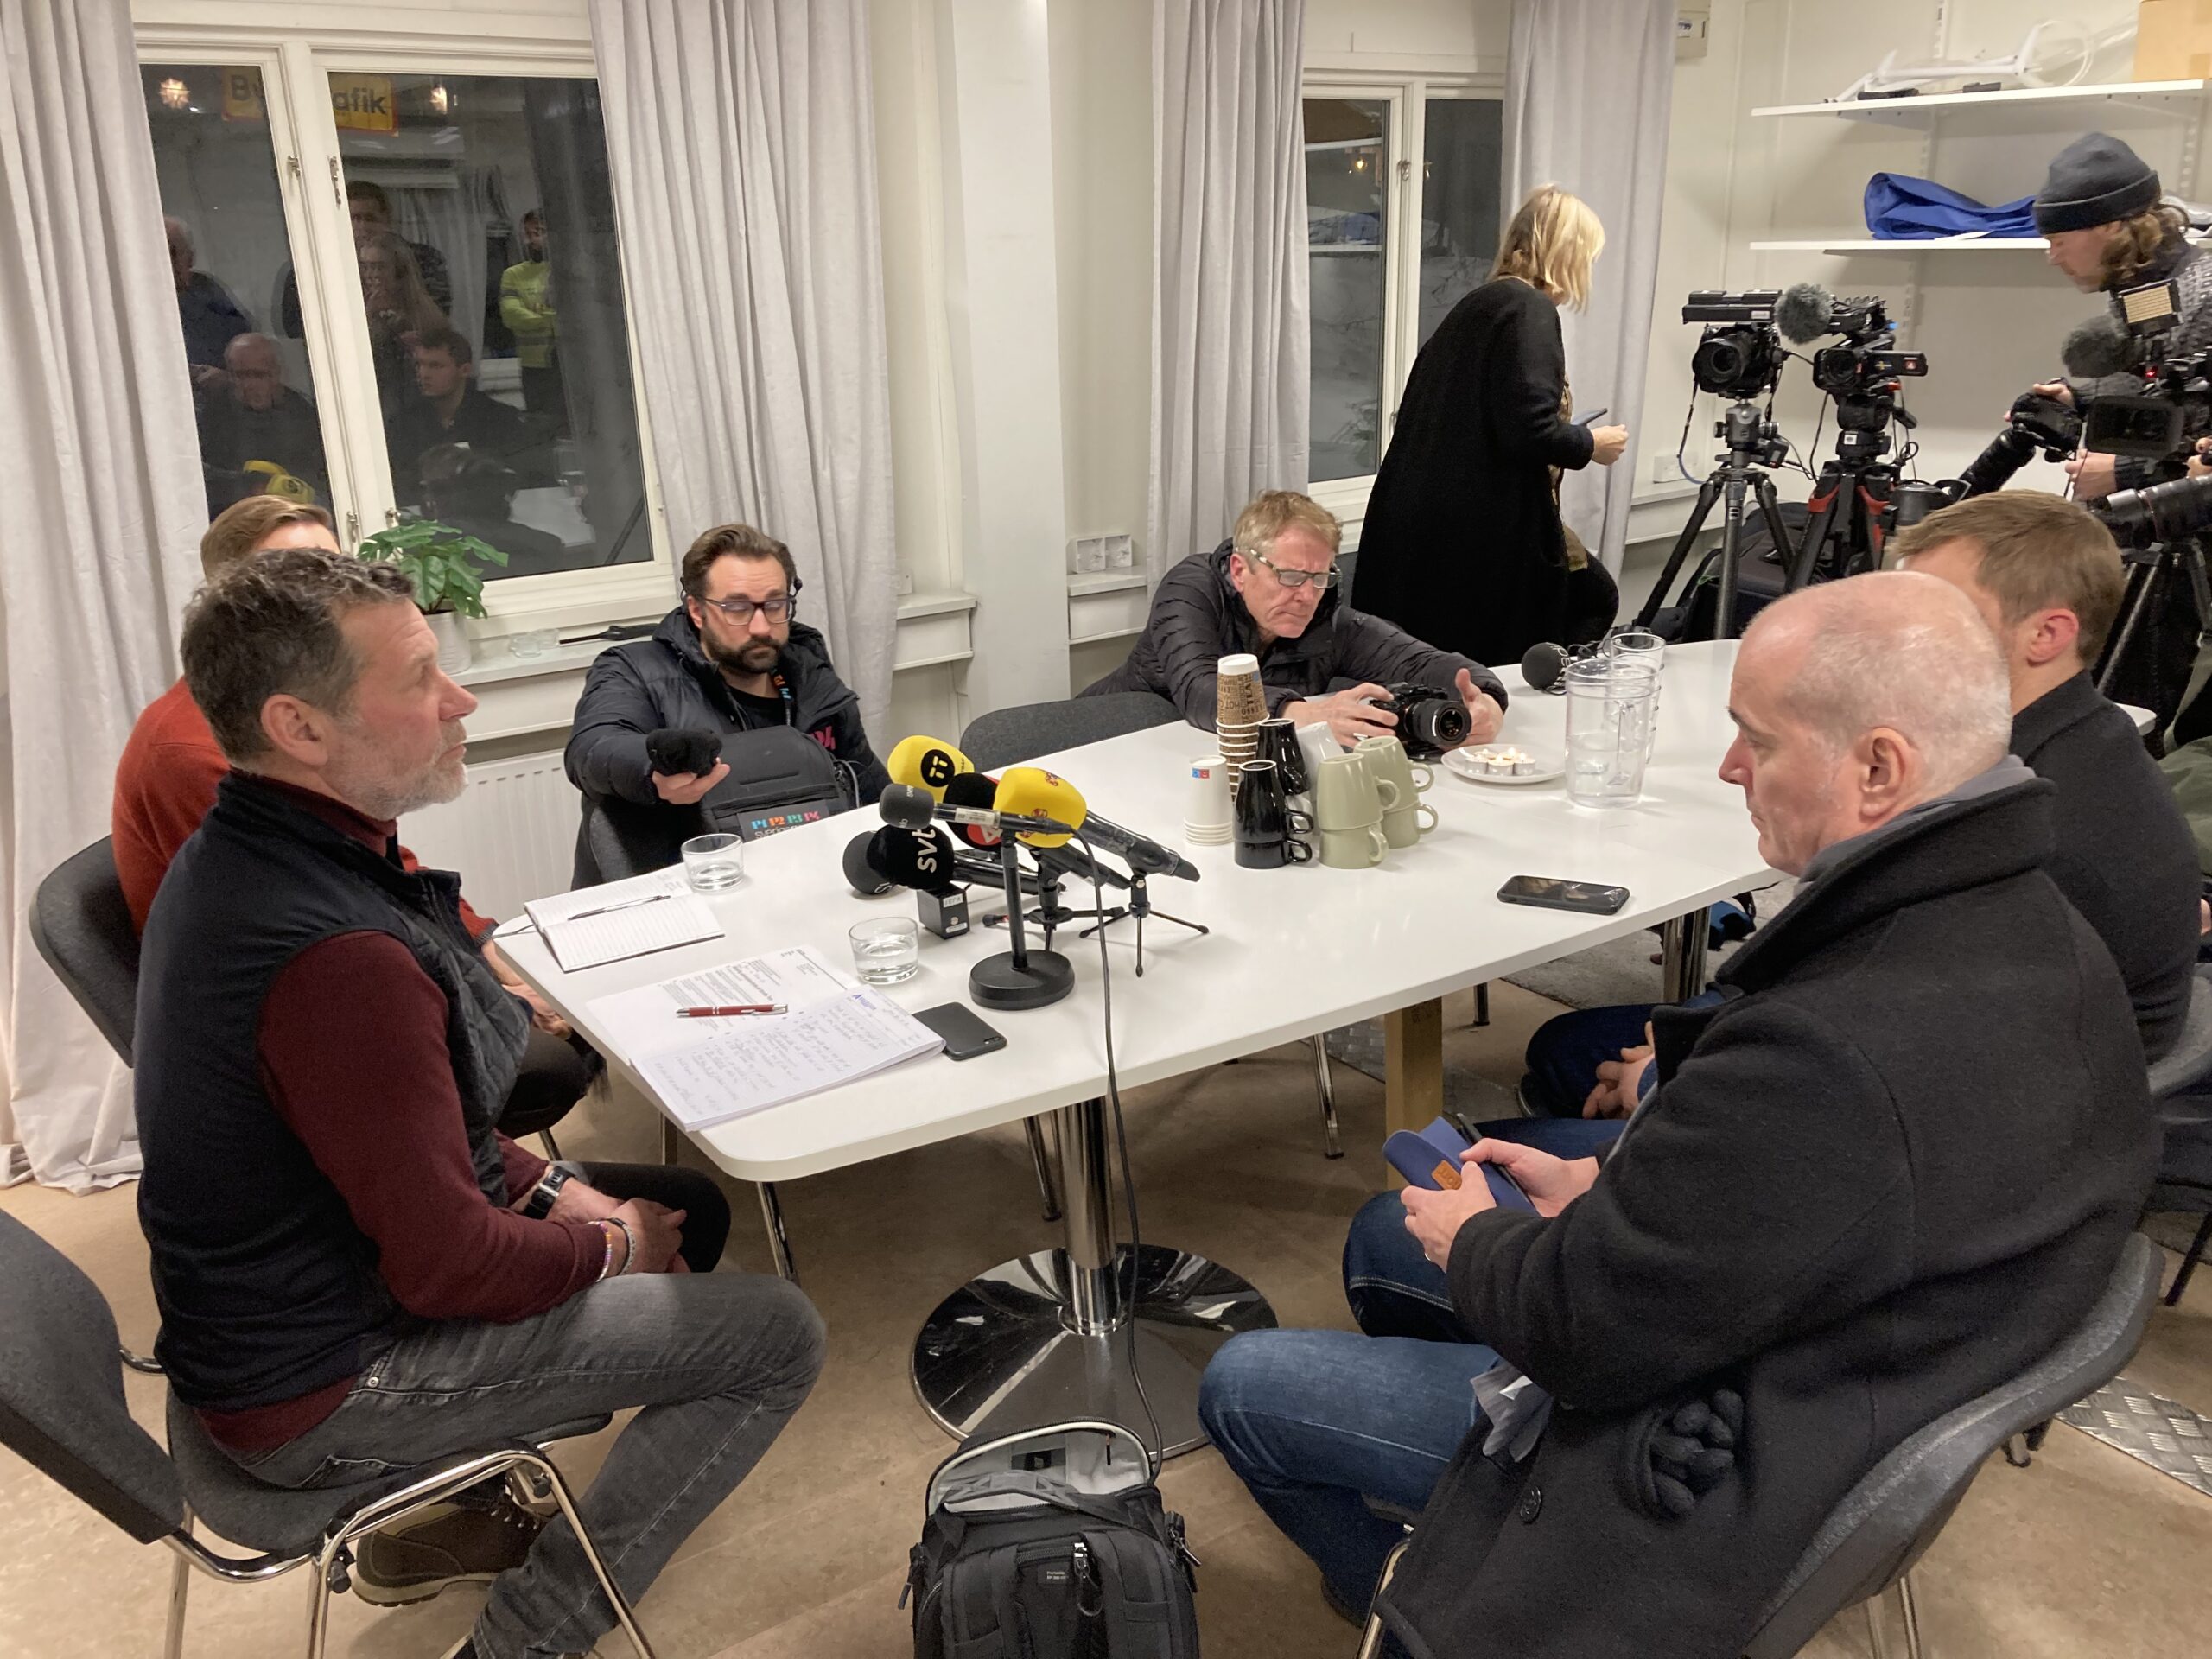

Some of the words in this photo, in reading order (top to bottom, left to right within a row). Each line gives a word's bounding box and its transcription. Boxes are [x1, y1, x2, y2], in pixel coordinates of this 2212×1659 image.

[751, 818, 768, 830] P1
[768, 816, 785, 826] P2
[786, 813, 804, 823] P3
[912, 829, 938, 874] svt
